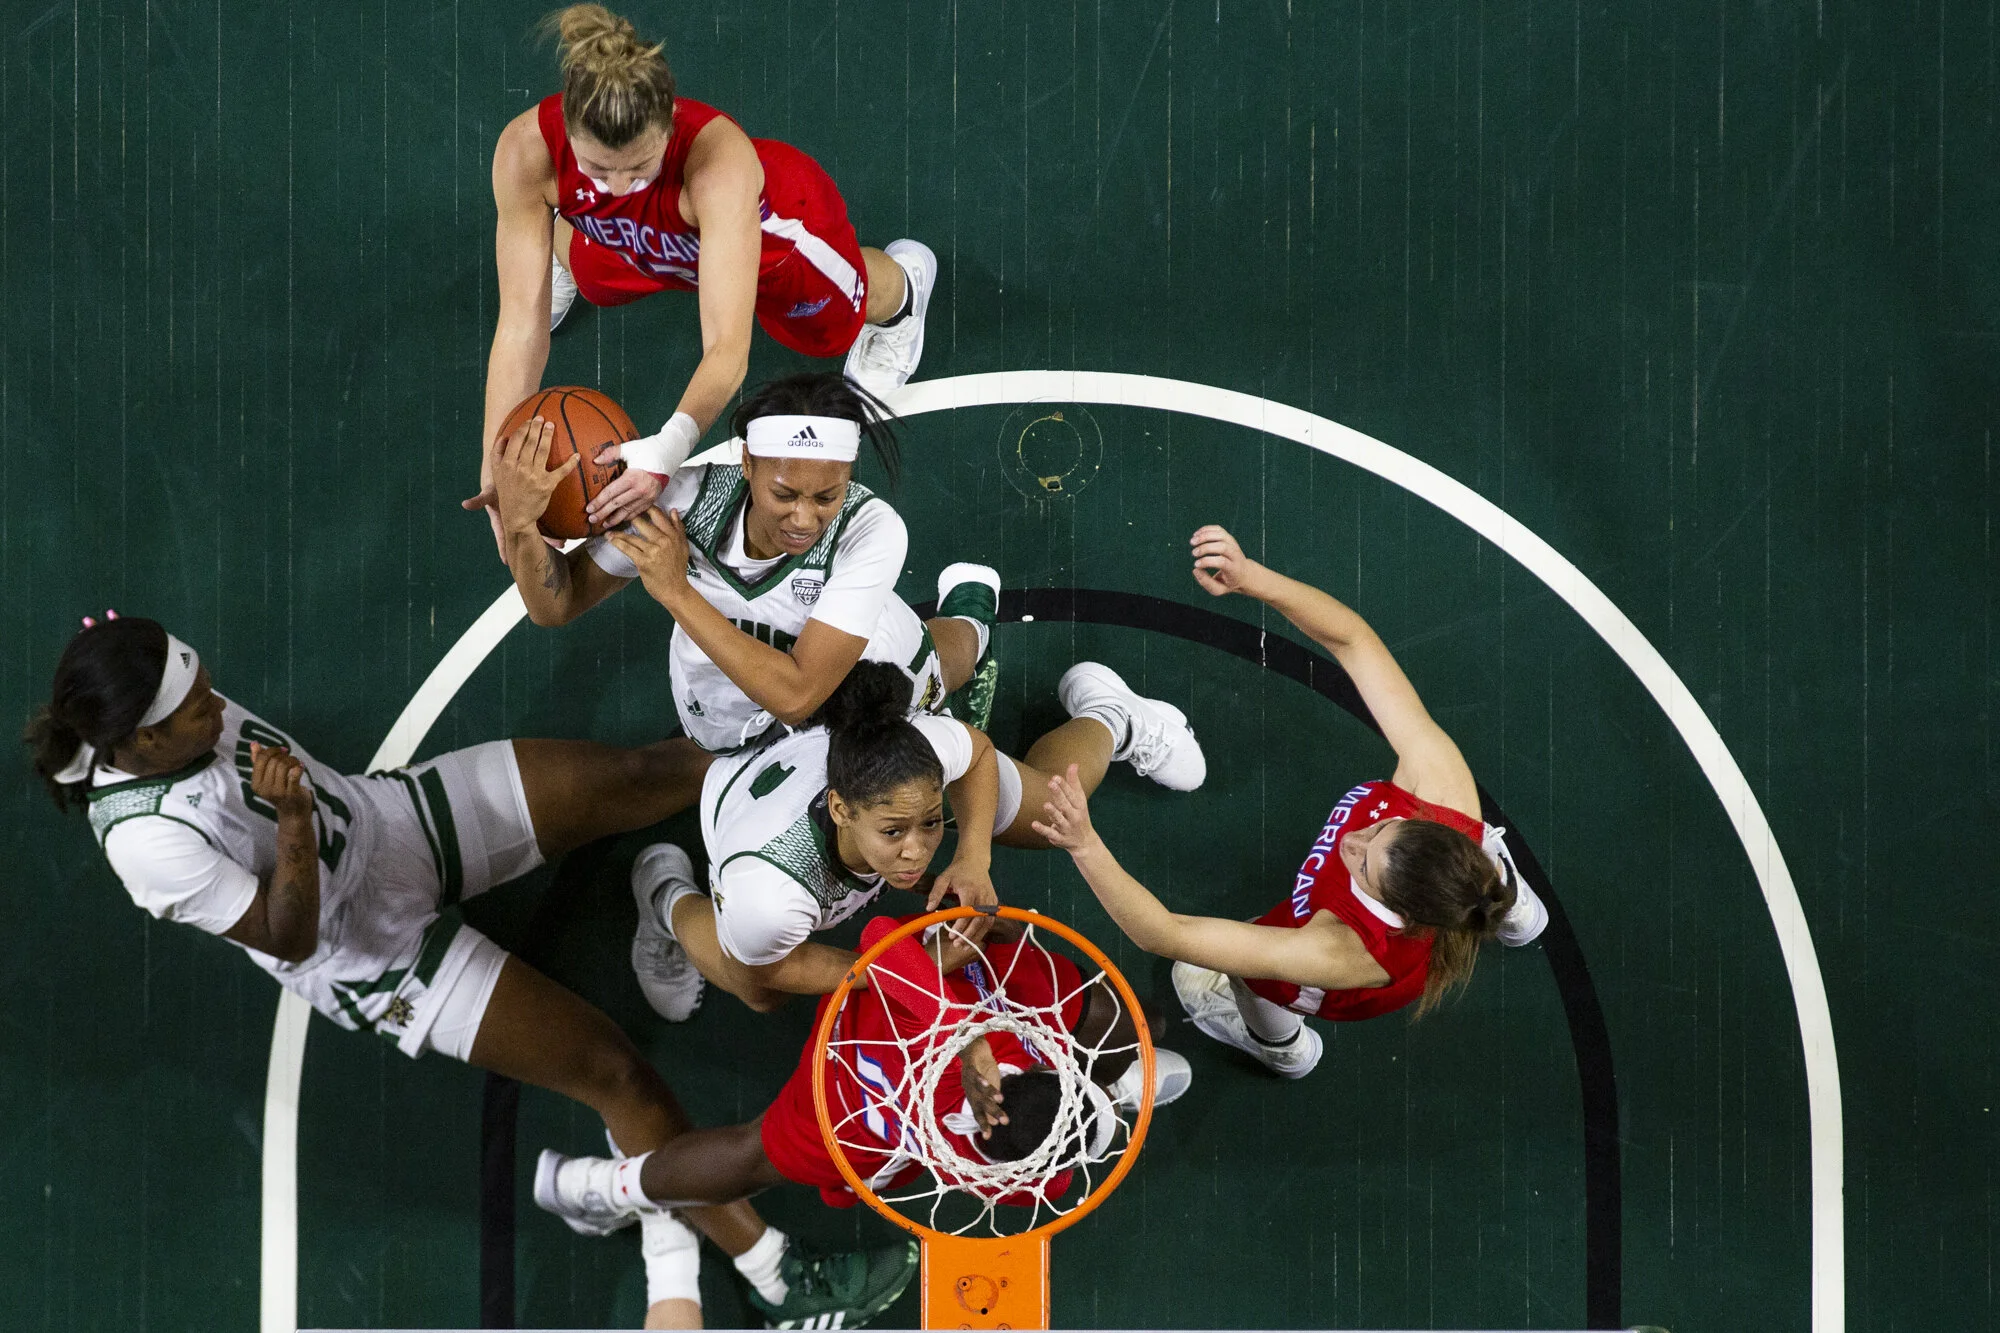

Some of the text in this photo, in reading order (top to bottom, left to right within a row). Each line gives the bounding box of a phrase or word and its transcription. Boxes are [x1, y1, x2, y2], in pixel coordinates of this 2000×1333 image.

[569, 215, 699, 262] MERICAN
[787, 438, 824, 448] adidas
[1291, 784, 1374, 919] MERICAN
